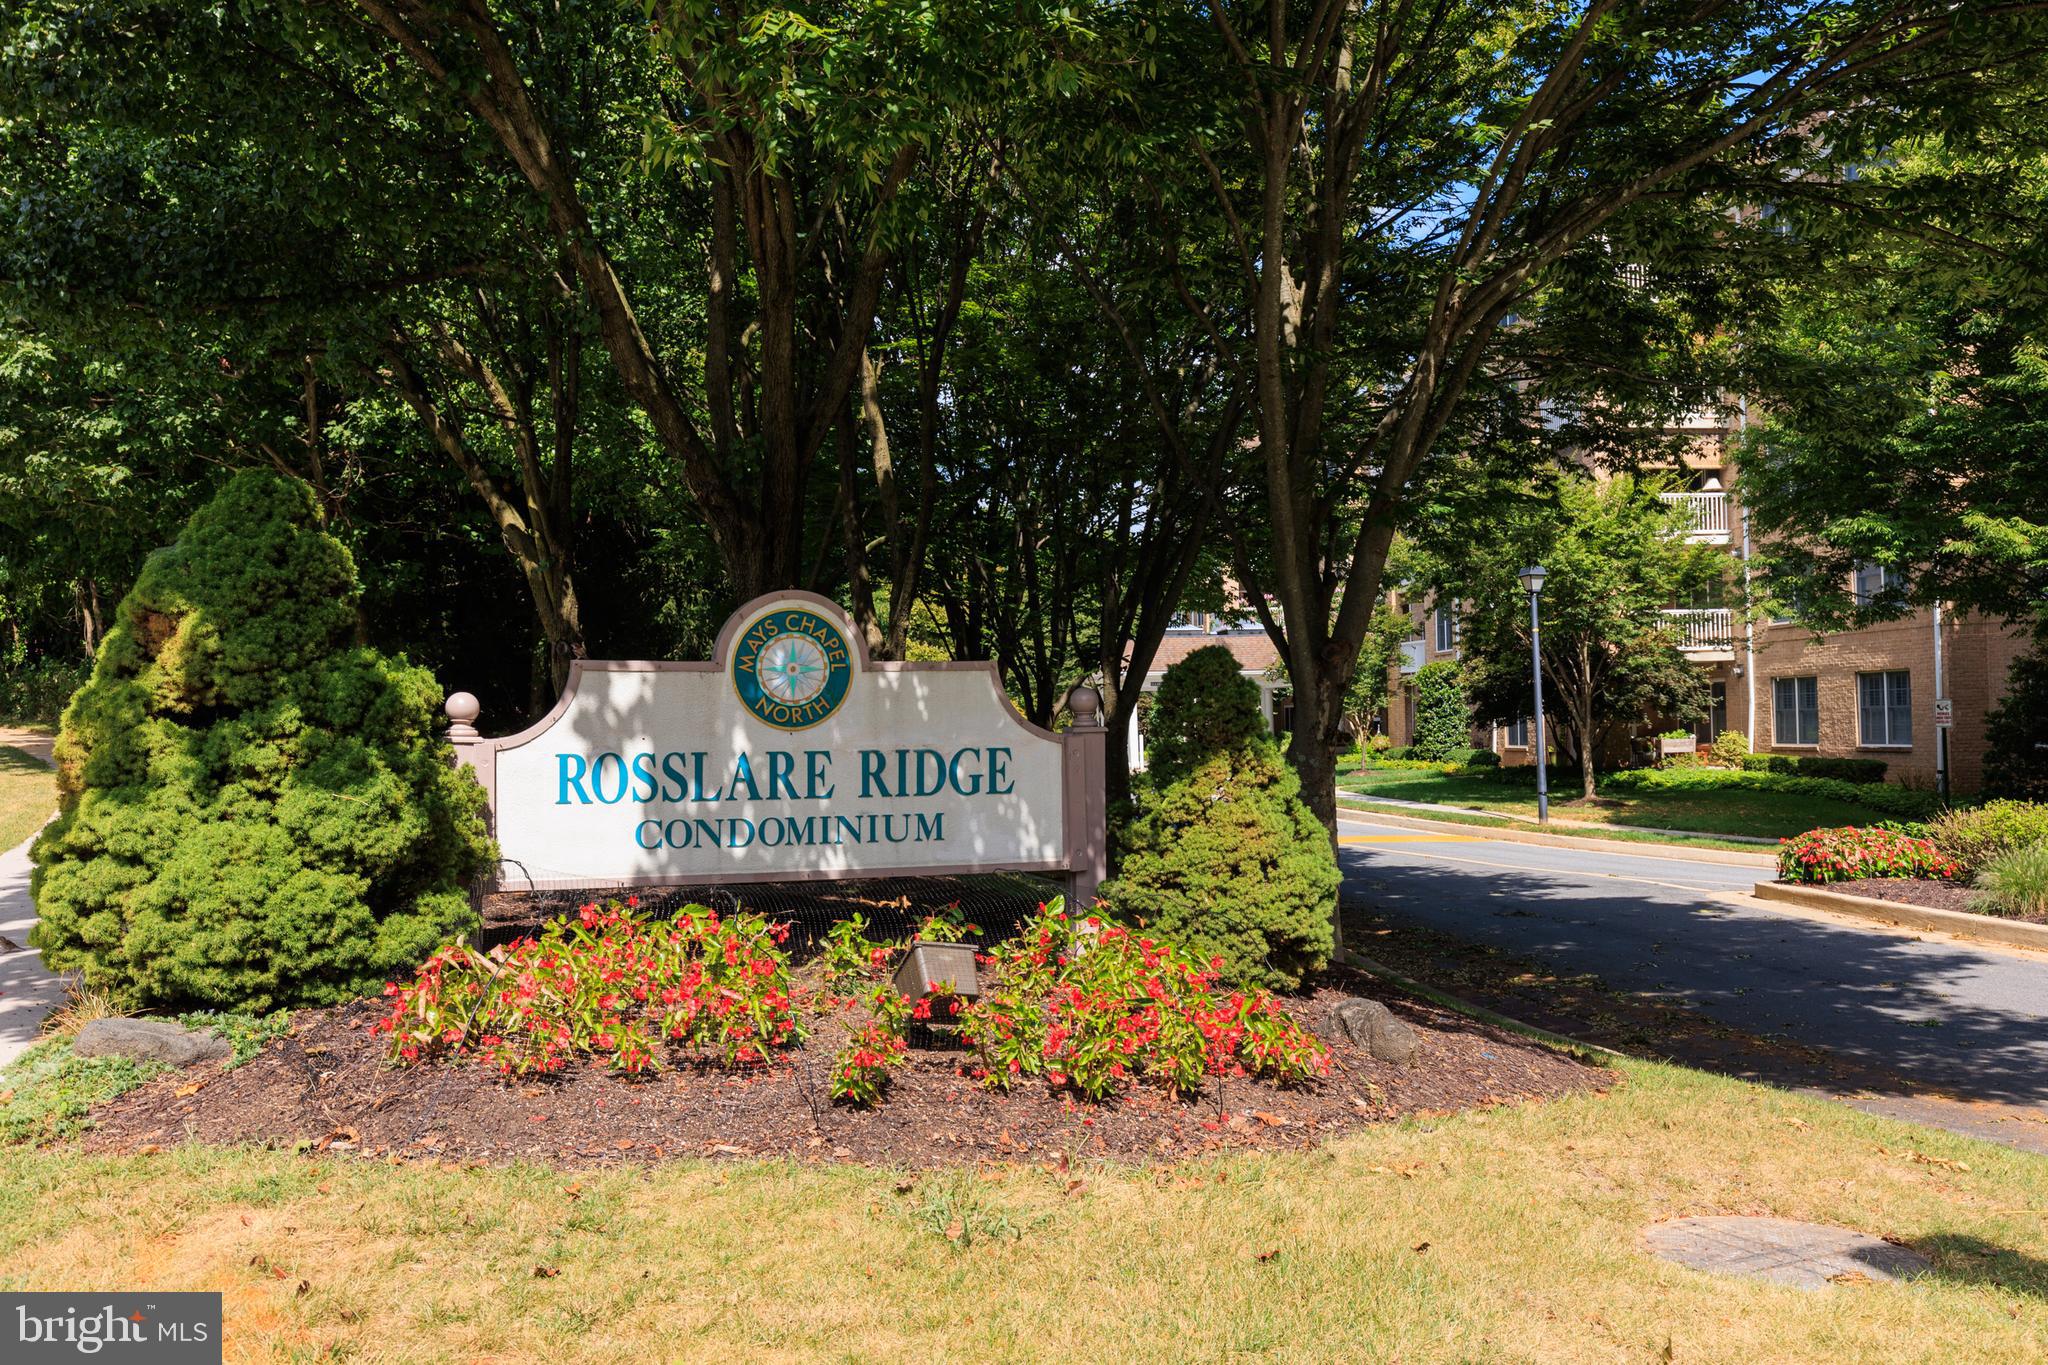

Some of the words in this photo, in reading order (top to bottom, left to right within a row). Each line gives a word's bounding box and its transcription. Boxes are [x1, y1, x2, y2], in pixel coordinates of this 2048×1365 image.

[739, 620, 778, 672] MAYS
[785, 614, 847, 672] CHAPEL
[755, 696, 830, 723] NORTH
[555, 750, 836, 805] ROSSLARE
[858, 747, 1016, 799] RIDGE
[635, 812, 945, 850] CONDOMINIUM
